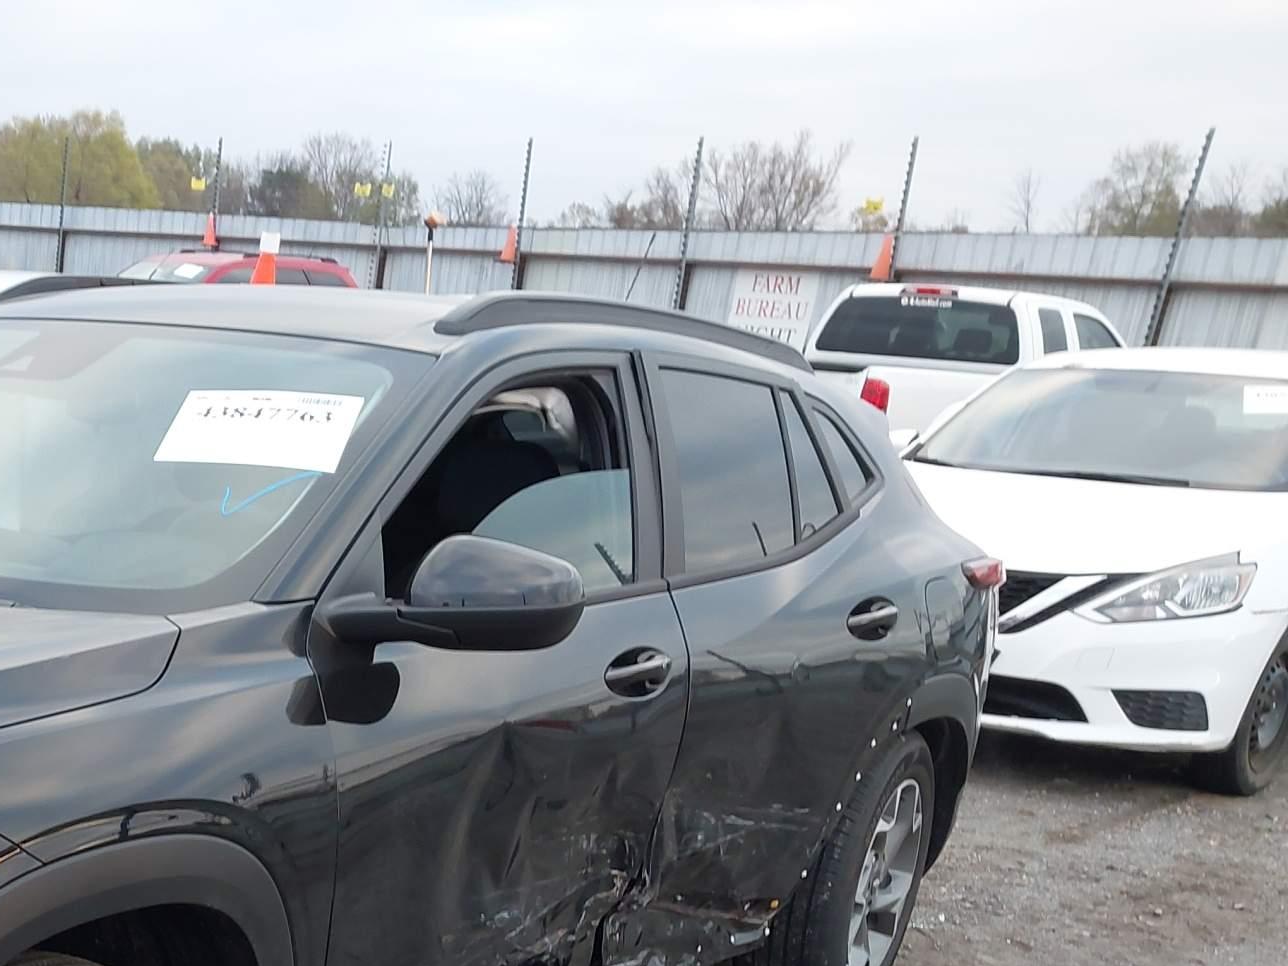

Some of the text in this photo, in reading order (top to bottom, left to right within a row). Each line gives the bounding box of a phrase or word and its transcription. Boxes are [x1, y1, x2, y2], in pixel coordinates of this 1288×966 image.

[752, 272, 802, 295] FARM
[735, 297, 809, 321] BUREAU
[197, 406, 332, 424] 43847763
